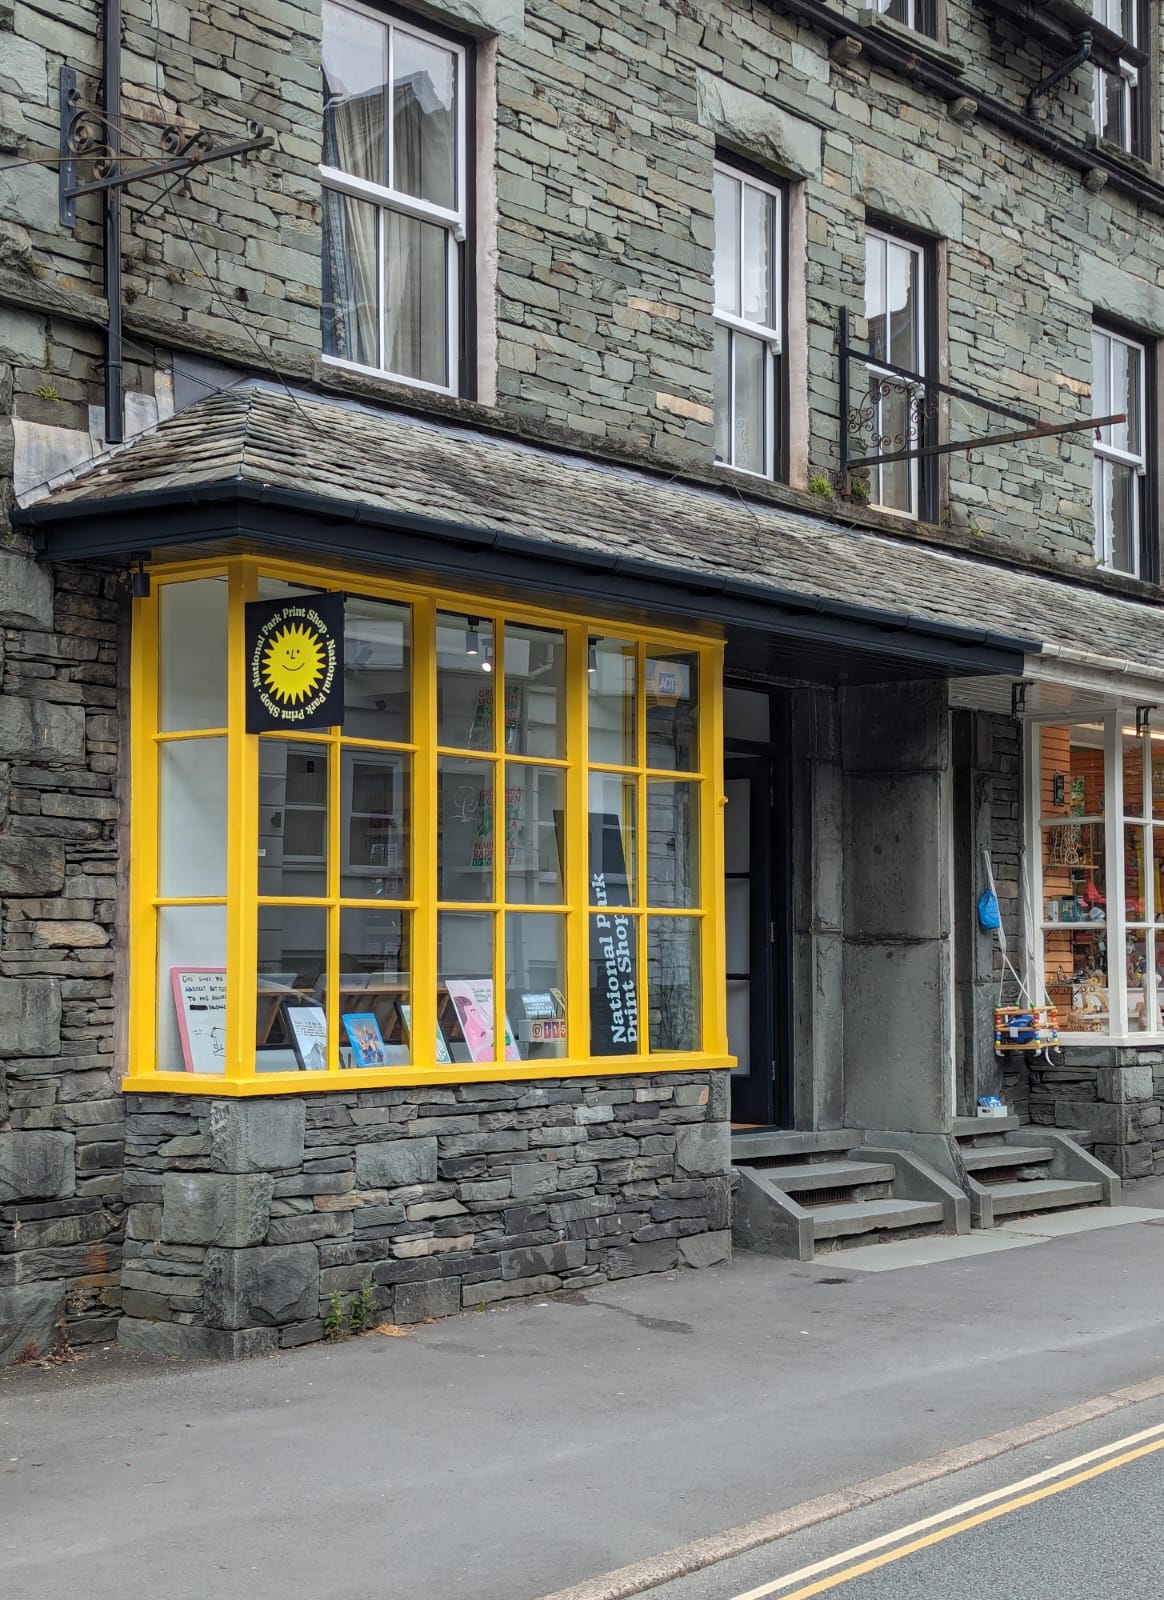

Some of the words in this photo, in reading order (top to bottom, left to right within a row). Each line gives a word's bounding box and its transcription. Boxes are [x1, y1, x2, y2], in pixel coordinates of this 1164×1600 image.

[252, 634, 265, 688] National
[261, 613, 282, 636] Park
[282, 605, 306, 619] Print
[307, 609, 328, 634] Shop
[323, 638, 337, 694] National
[260, 692, 281, 718] Shop
[305, 692, 327, 715] Park
[659, 676, 676, 691] ADT
[281, 708, 305, 722] Print
[614, 904, 632, 974] Shop
[598, 936, 627, 1043] National
[622, 979, 638, 1043] Print
